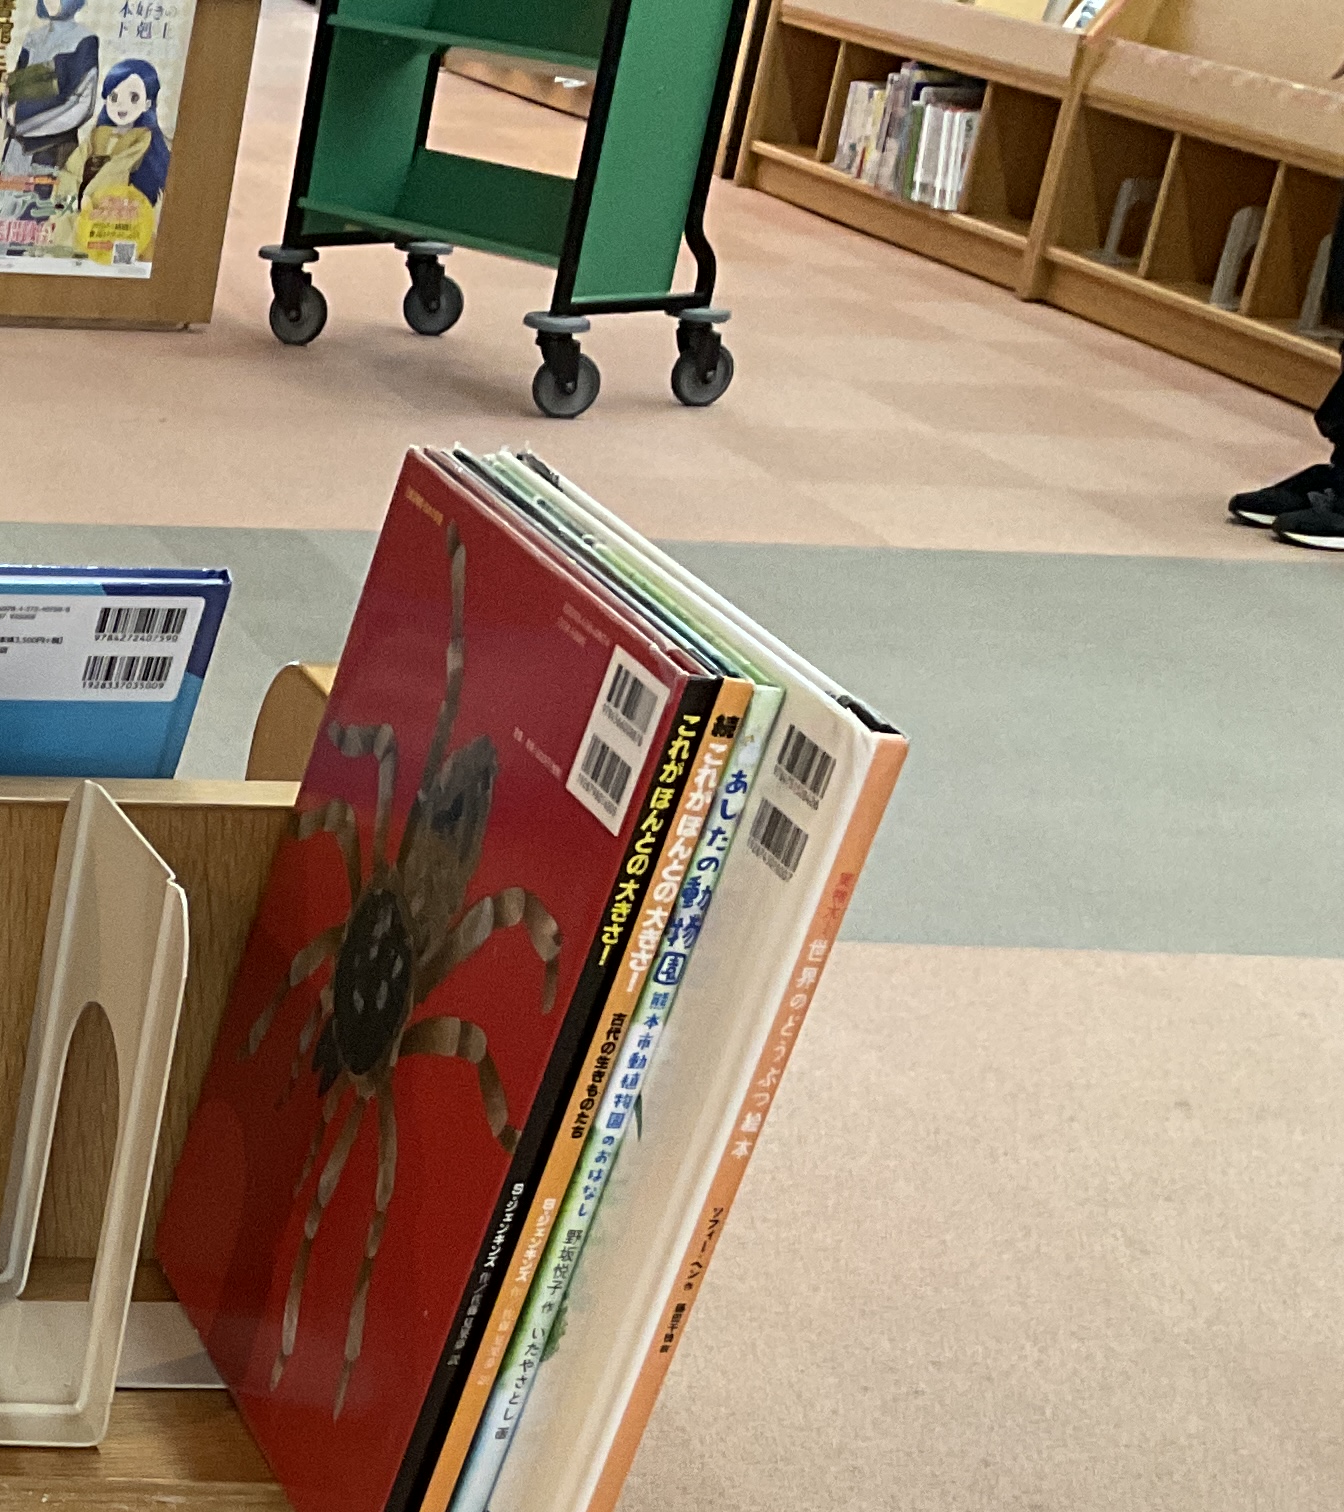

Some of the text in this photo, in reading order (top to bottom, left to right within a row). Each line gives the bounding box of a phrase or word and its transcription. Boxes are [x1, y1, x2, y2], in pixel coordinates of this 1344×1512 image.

[598, 713, 703, 967] これが ほんとの 大きさ!
[624, 713, 741, 994] 続 これが ほんとの 大きさ!
[578, 992, 669, 1217] 熊本市動植物園のおはなし
[503, 1327, 545, 1422] いたやさとし
